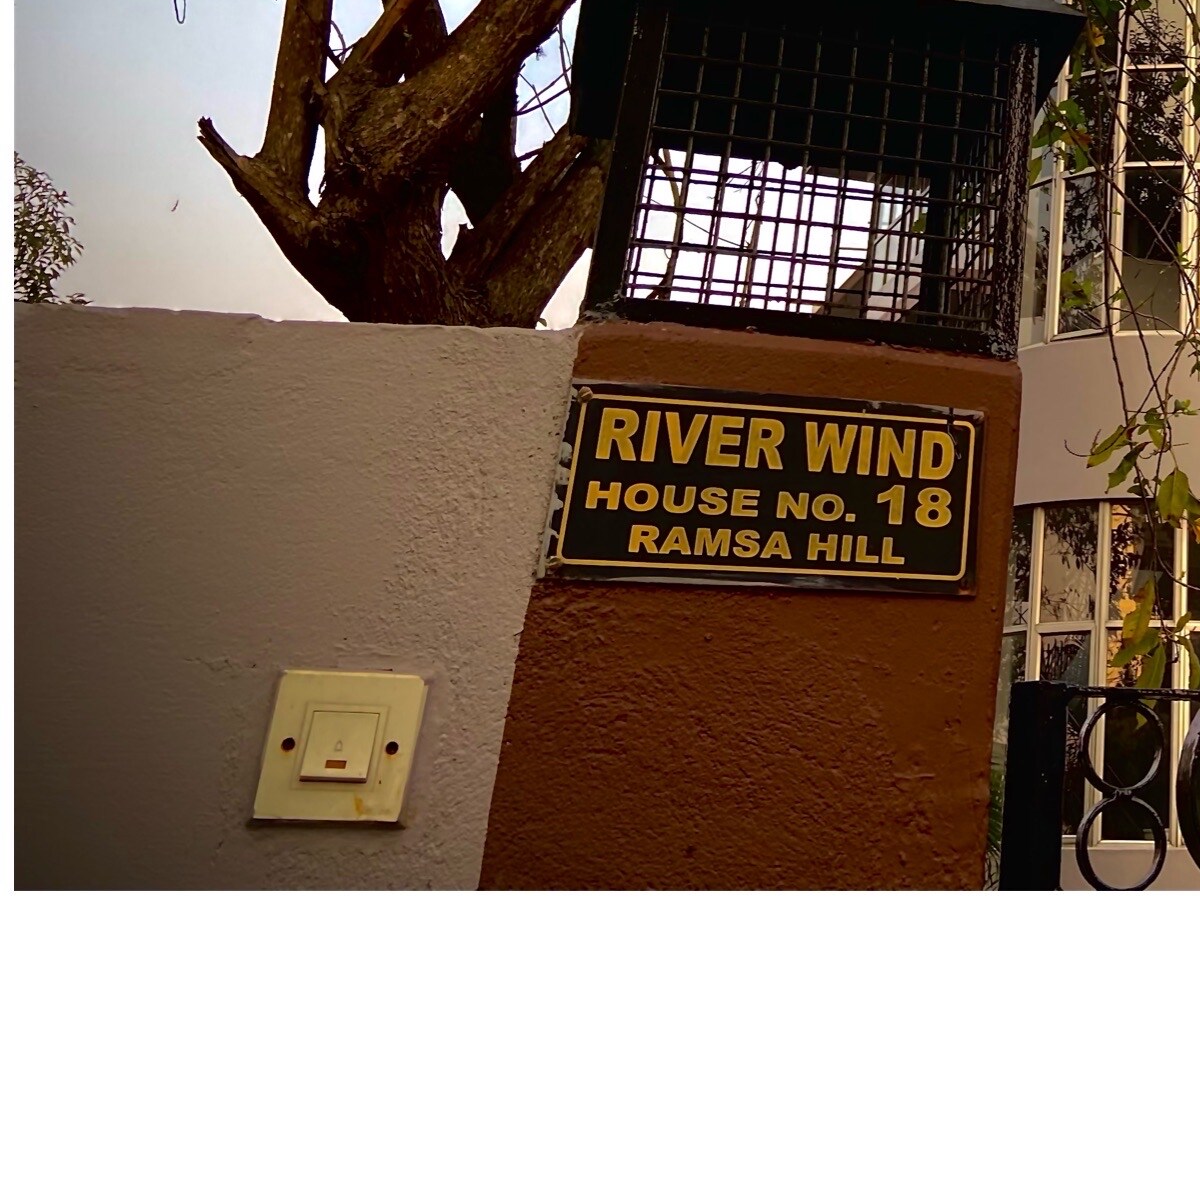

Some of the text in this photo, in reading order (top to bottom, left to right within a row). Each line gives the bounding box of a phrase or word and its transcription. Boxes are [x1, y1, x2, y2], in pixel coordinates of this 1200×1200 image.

[596, 407, 955, 480] RIVER WIND
[585, 480, 953, 527] HOUSE NO. 18
[628, 524, 906, 564] RAMSA HILL
